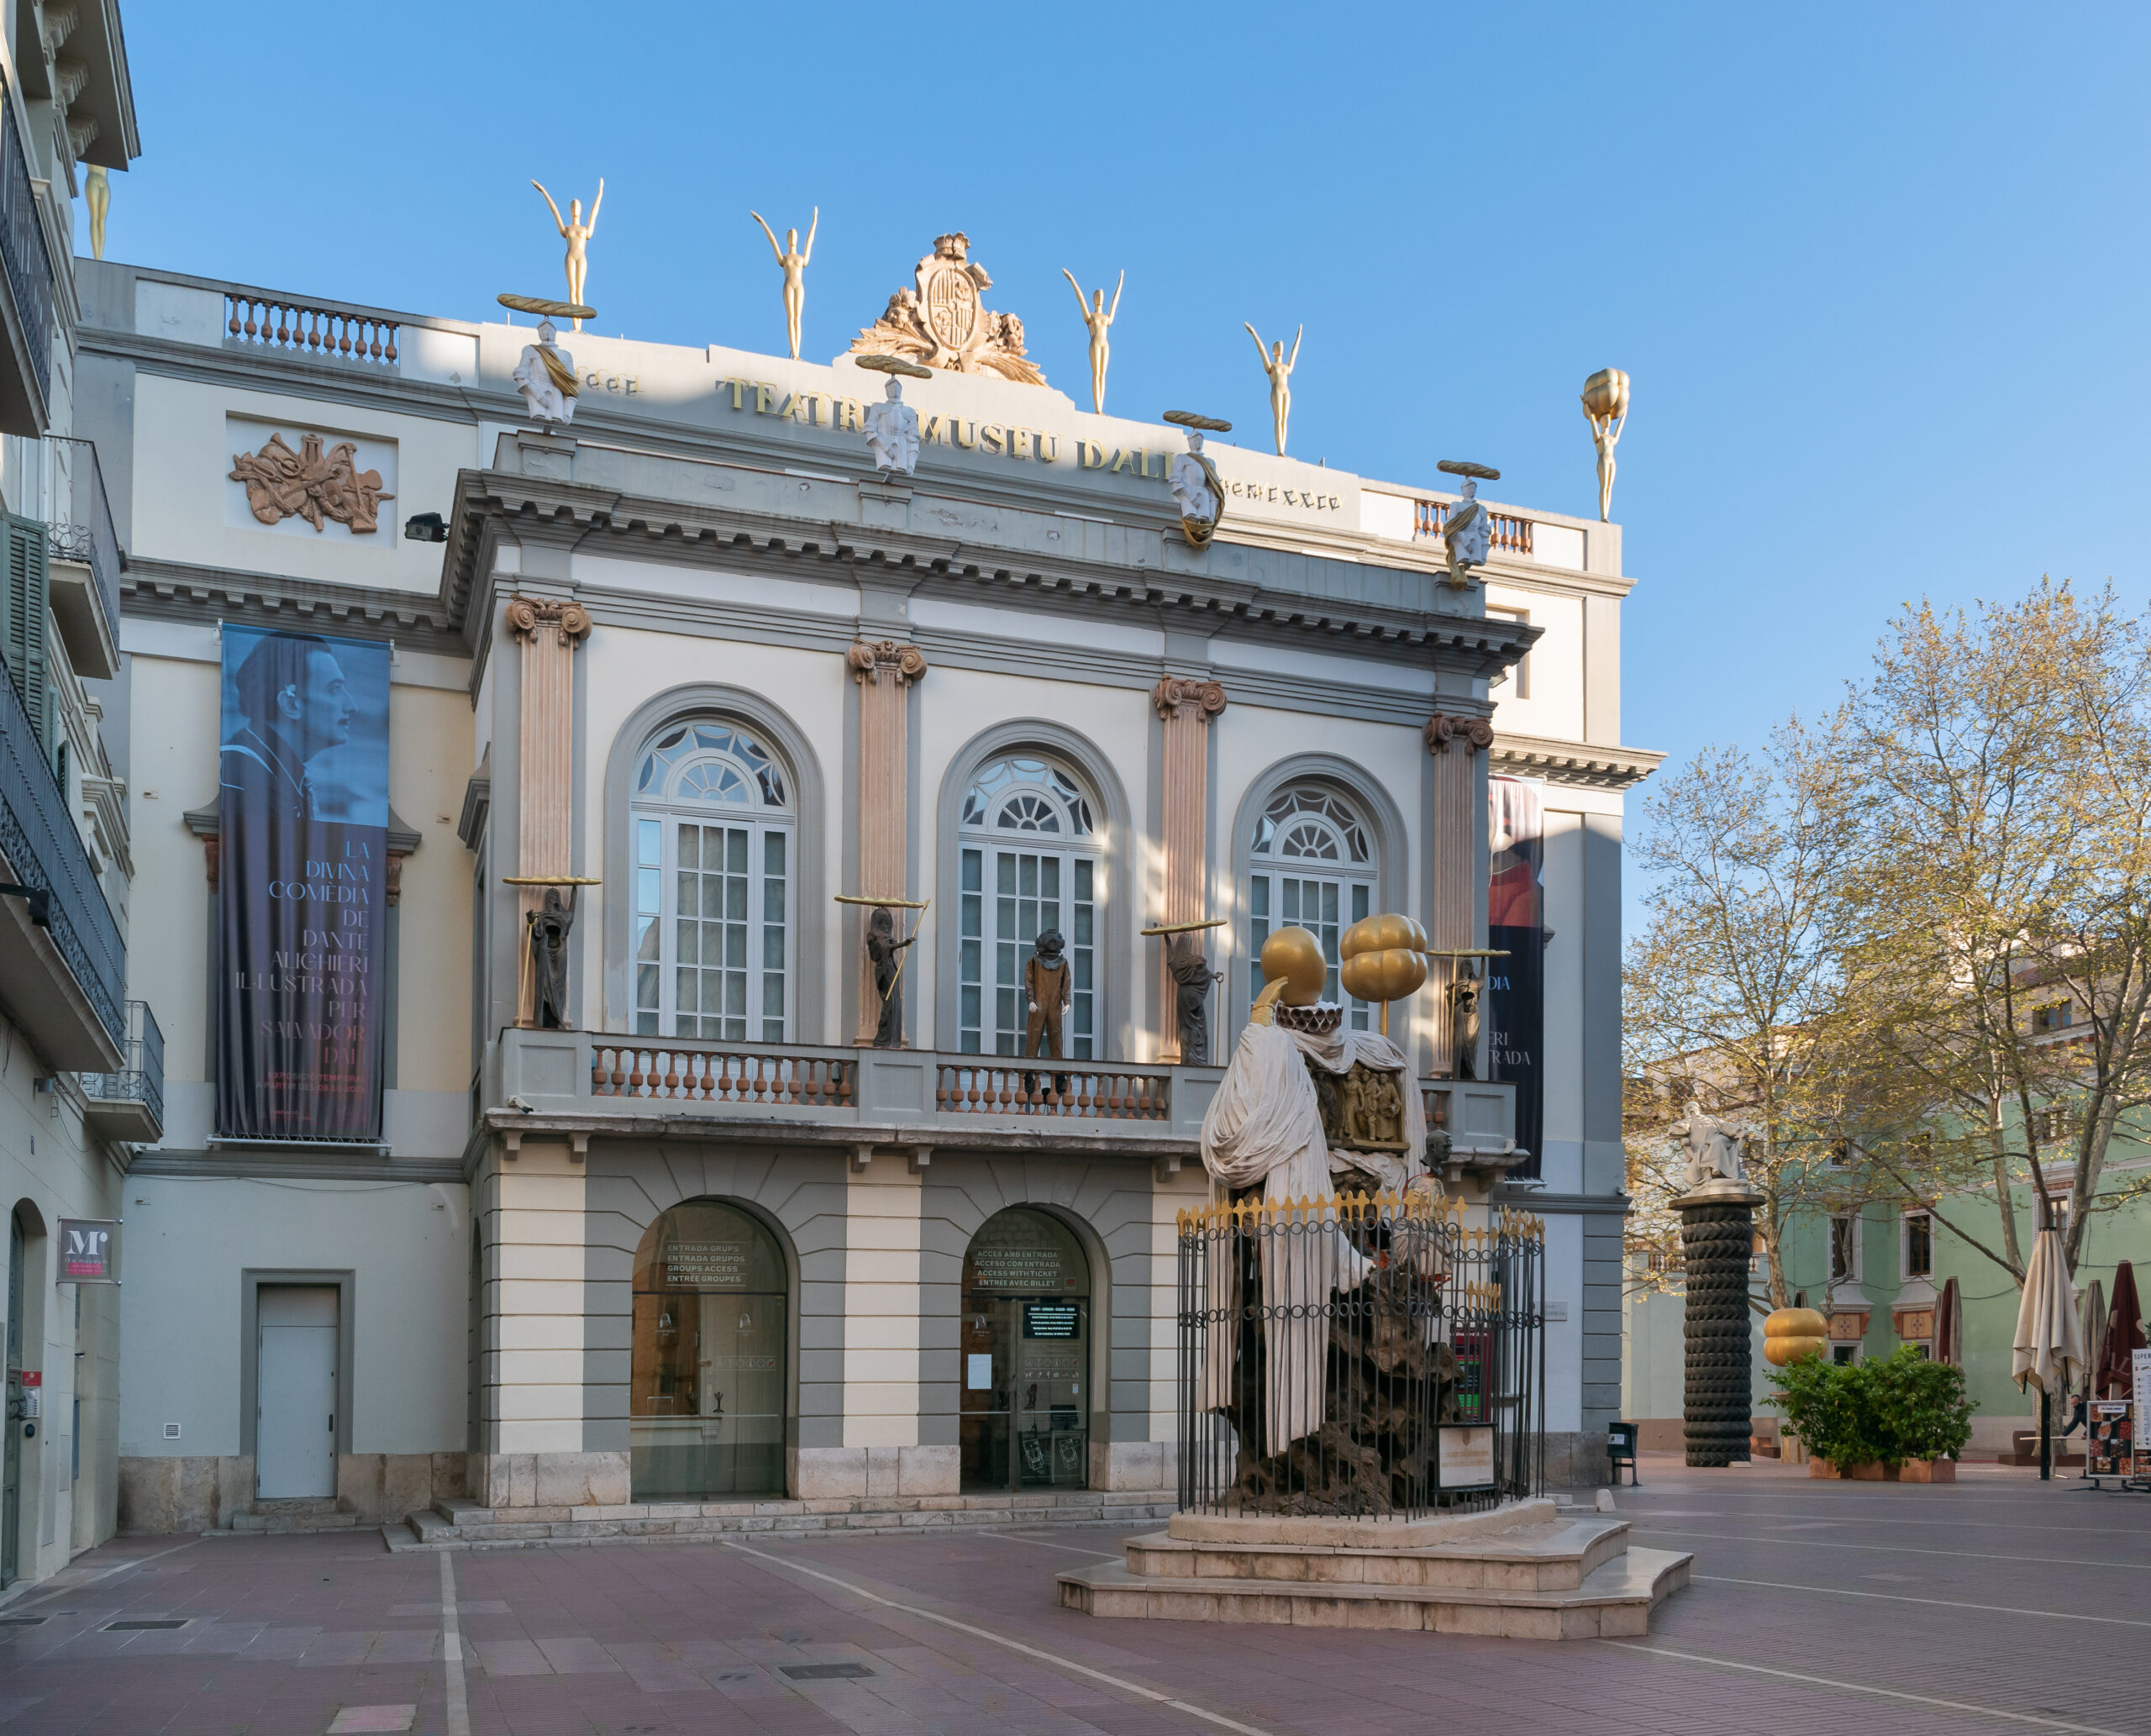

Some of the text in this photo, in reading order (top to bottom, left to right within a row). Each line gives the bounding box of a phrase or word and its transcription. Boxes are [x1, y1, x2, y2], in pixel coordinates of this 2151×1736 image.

[723, 376, 874, 429] TEATR
[916, 408, 1065, 463] MUSEU
[346, 840, 370, 859] LA
[307, 860, 370, 881] DIVINA
[269, 881, 369, 904] COMÈDIA
[344, 909, 369, 928] DE
[303, 929, 368, 950] DANTE
[272, 951, 367, 973] ALIGHIERI
[329, 1001, 365, 1019] PER
[261, 1021, 365, 1043] SALVADOR
[667, 1274, 699, 1282] ENTRÉE
